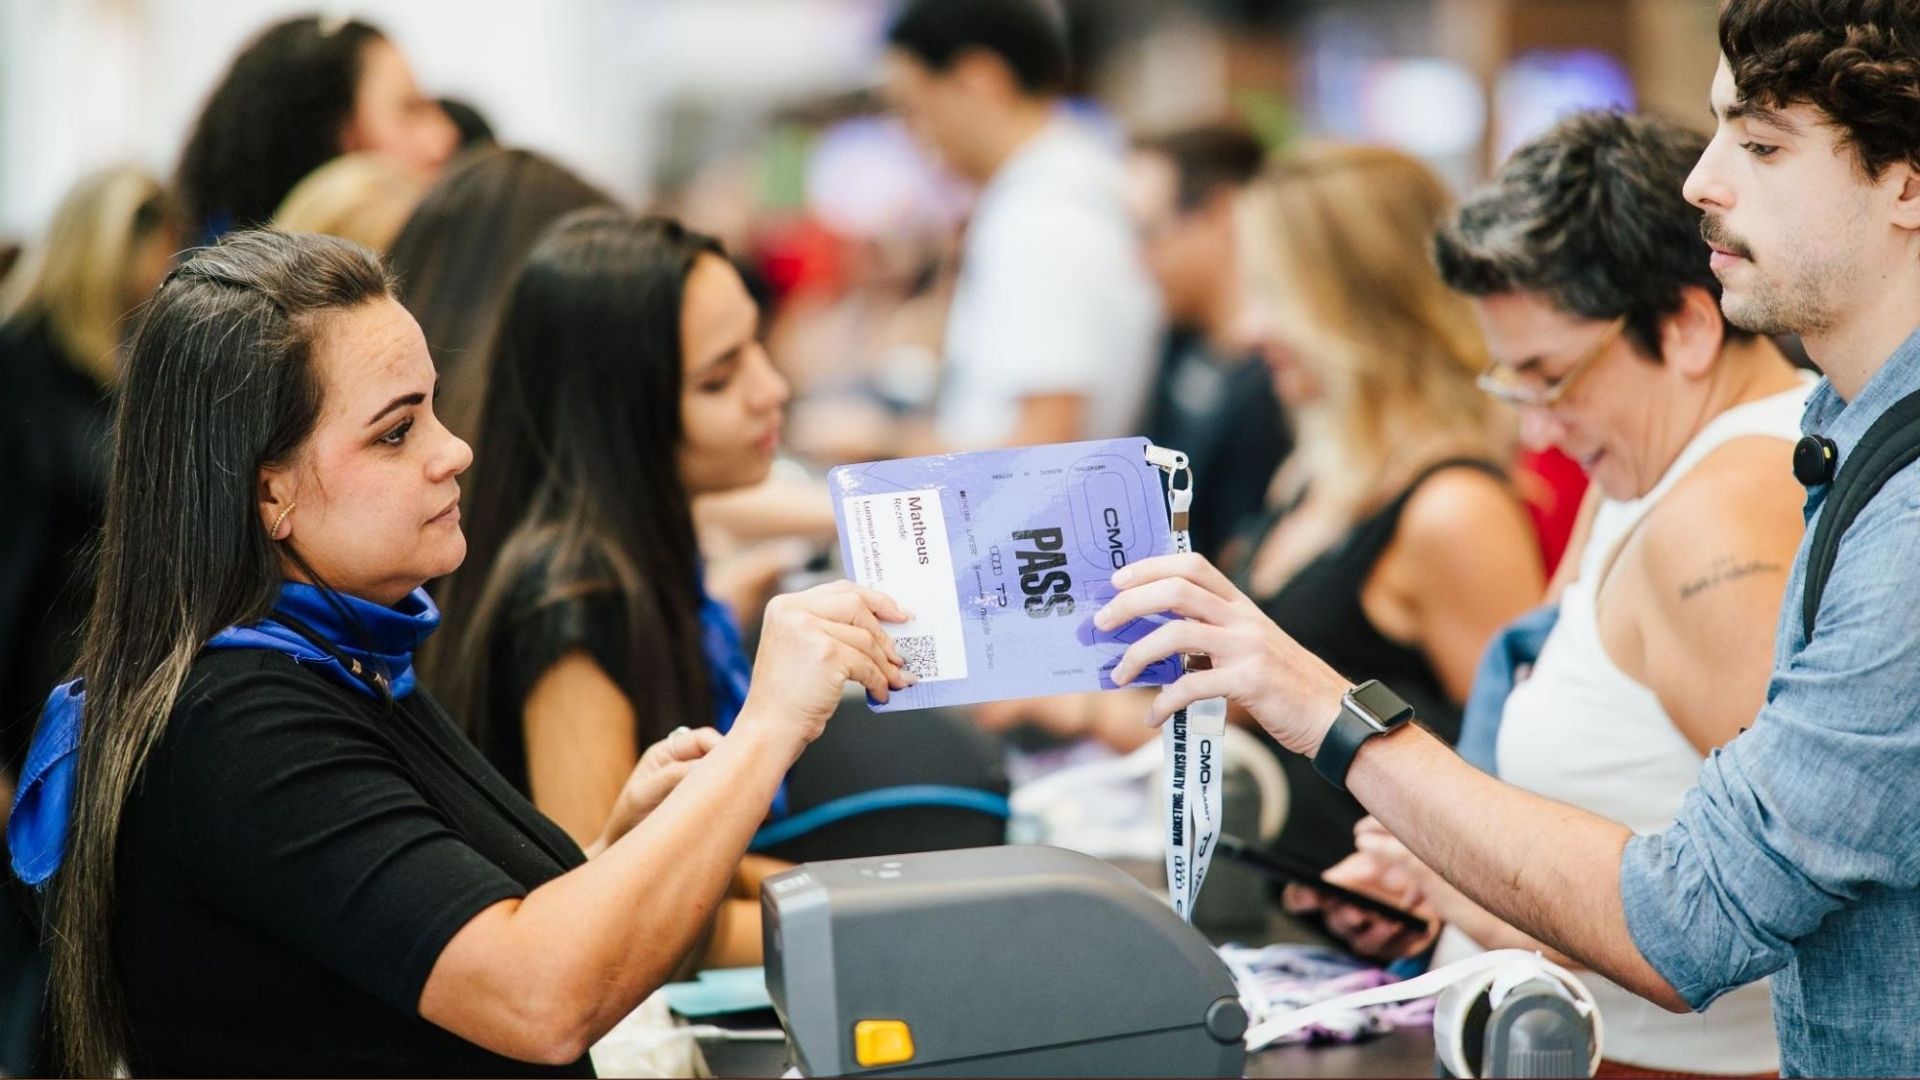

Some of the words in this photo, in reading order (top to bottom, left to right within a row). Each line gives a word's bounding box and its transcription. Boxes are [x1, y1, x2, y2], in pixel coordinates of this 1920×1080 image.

[893, 497, 908, 541] Rezende
[907, 496, 930, 566] Matheus
[1103, 507, 1127, 570] CMO
[1012, 527, 1075, 619] PASS
[1173, 753, 1187, 790] ALWAYS
[1174, 742, 1187, 753] IN
[1199, 739, 1212, 784] CMO
[1172, 791, 1185, 847] MARKETING.
